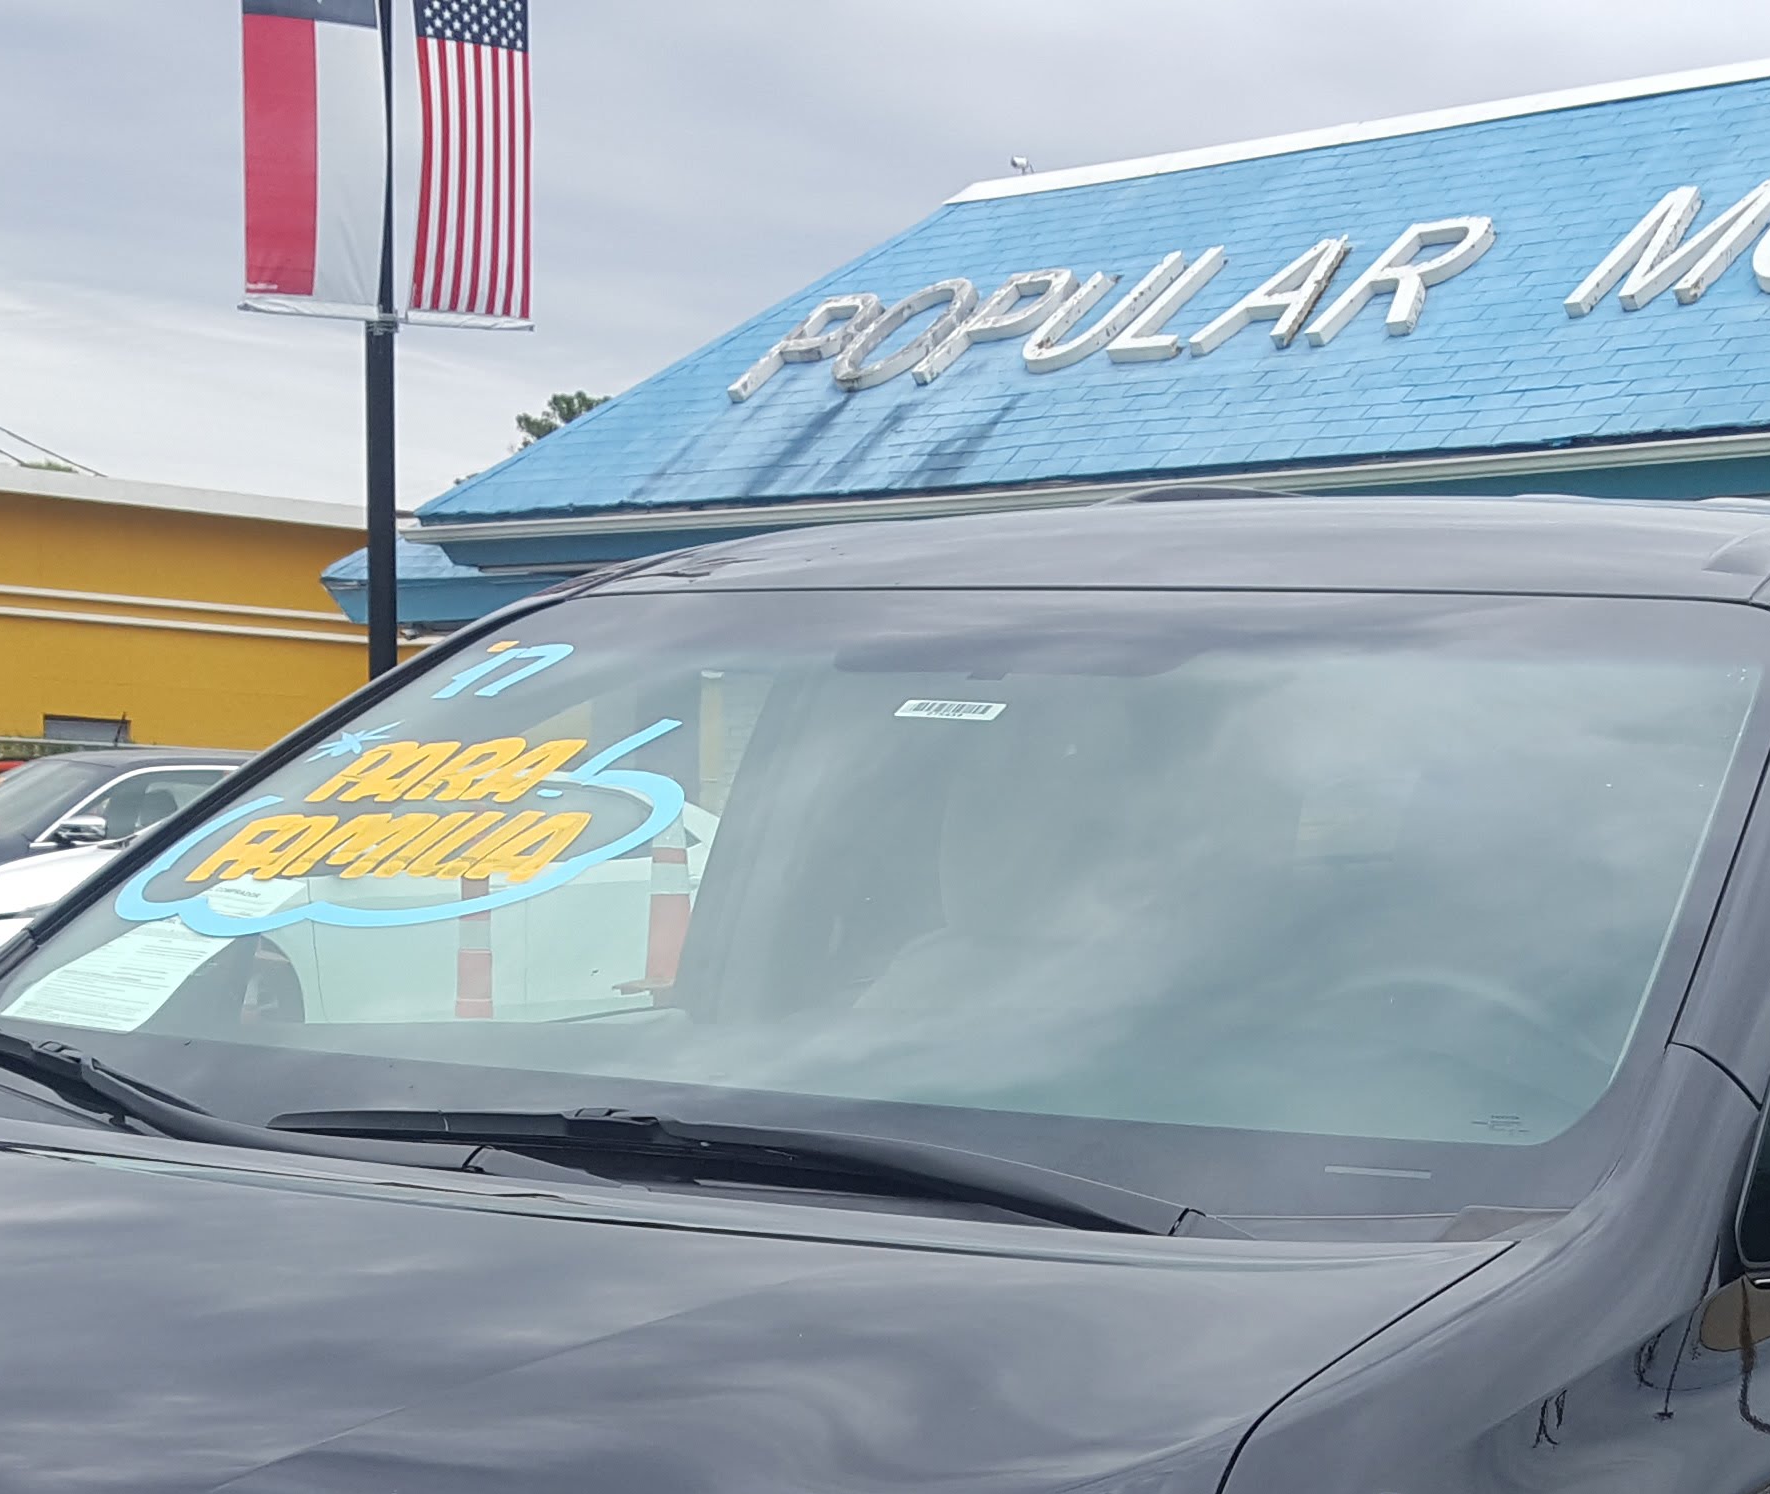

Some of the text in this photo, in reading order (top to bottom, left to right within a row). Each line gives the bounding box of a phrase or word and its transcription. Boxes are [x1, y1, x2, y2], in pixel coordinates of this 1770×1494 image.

[727, 214, 1497, 403] POPULAR
[305, 737, 588, 802] PARA
[185, 811, 592, 882] FAMILIA
